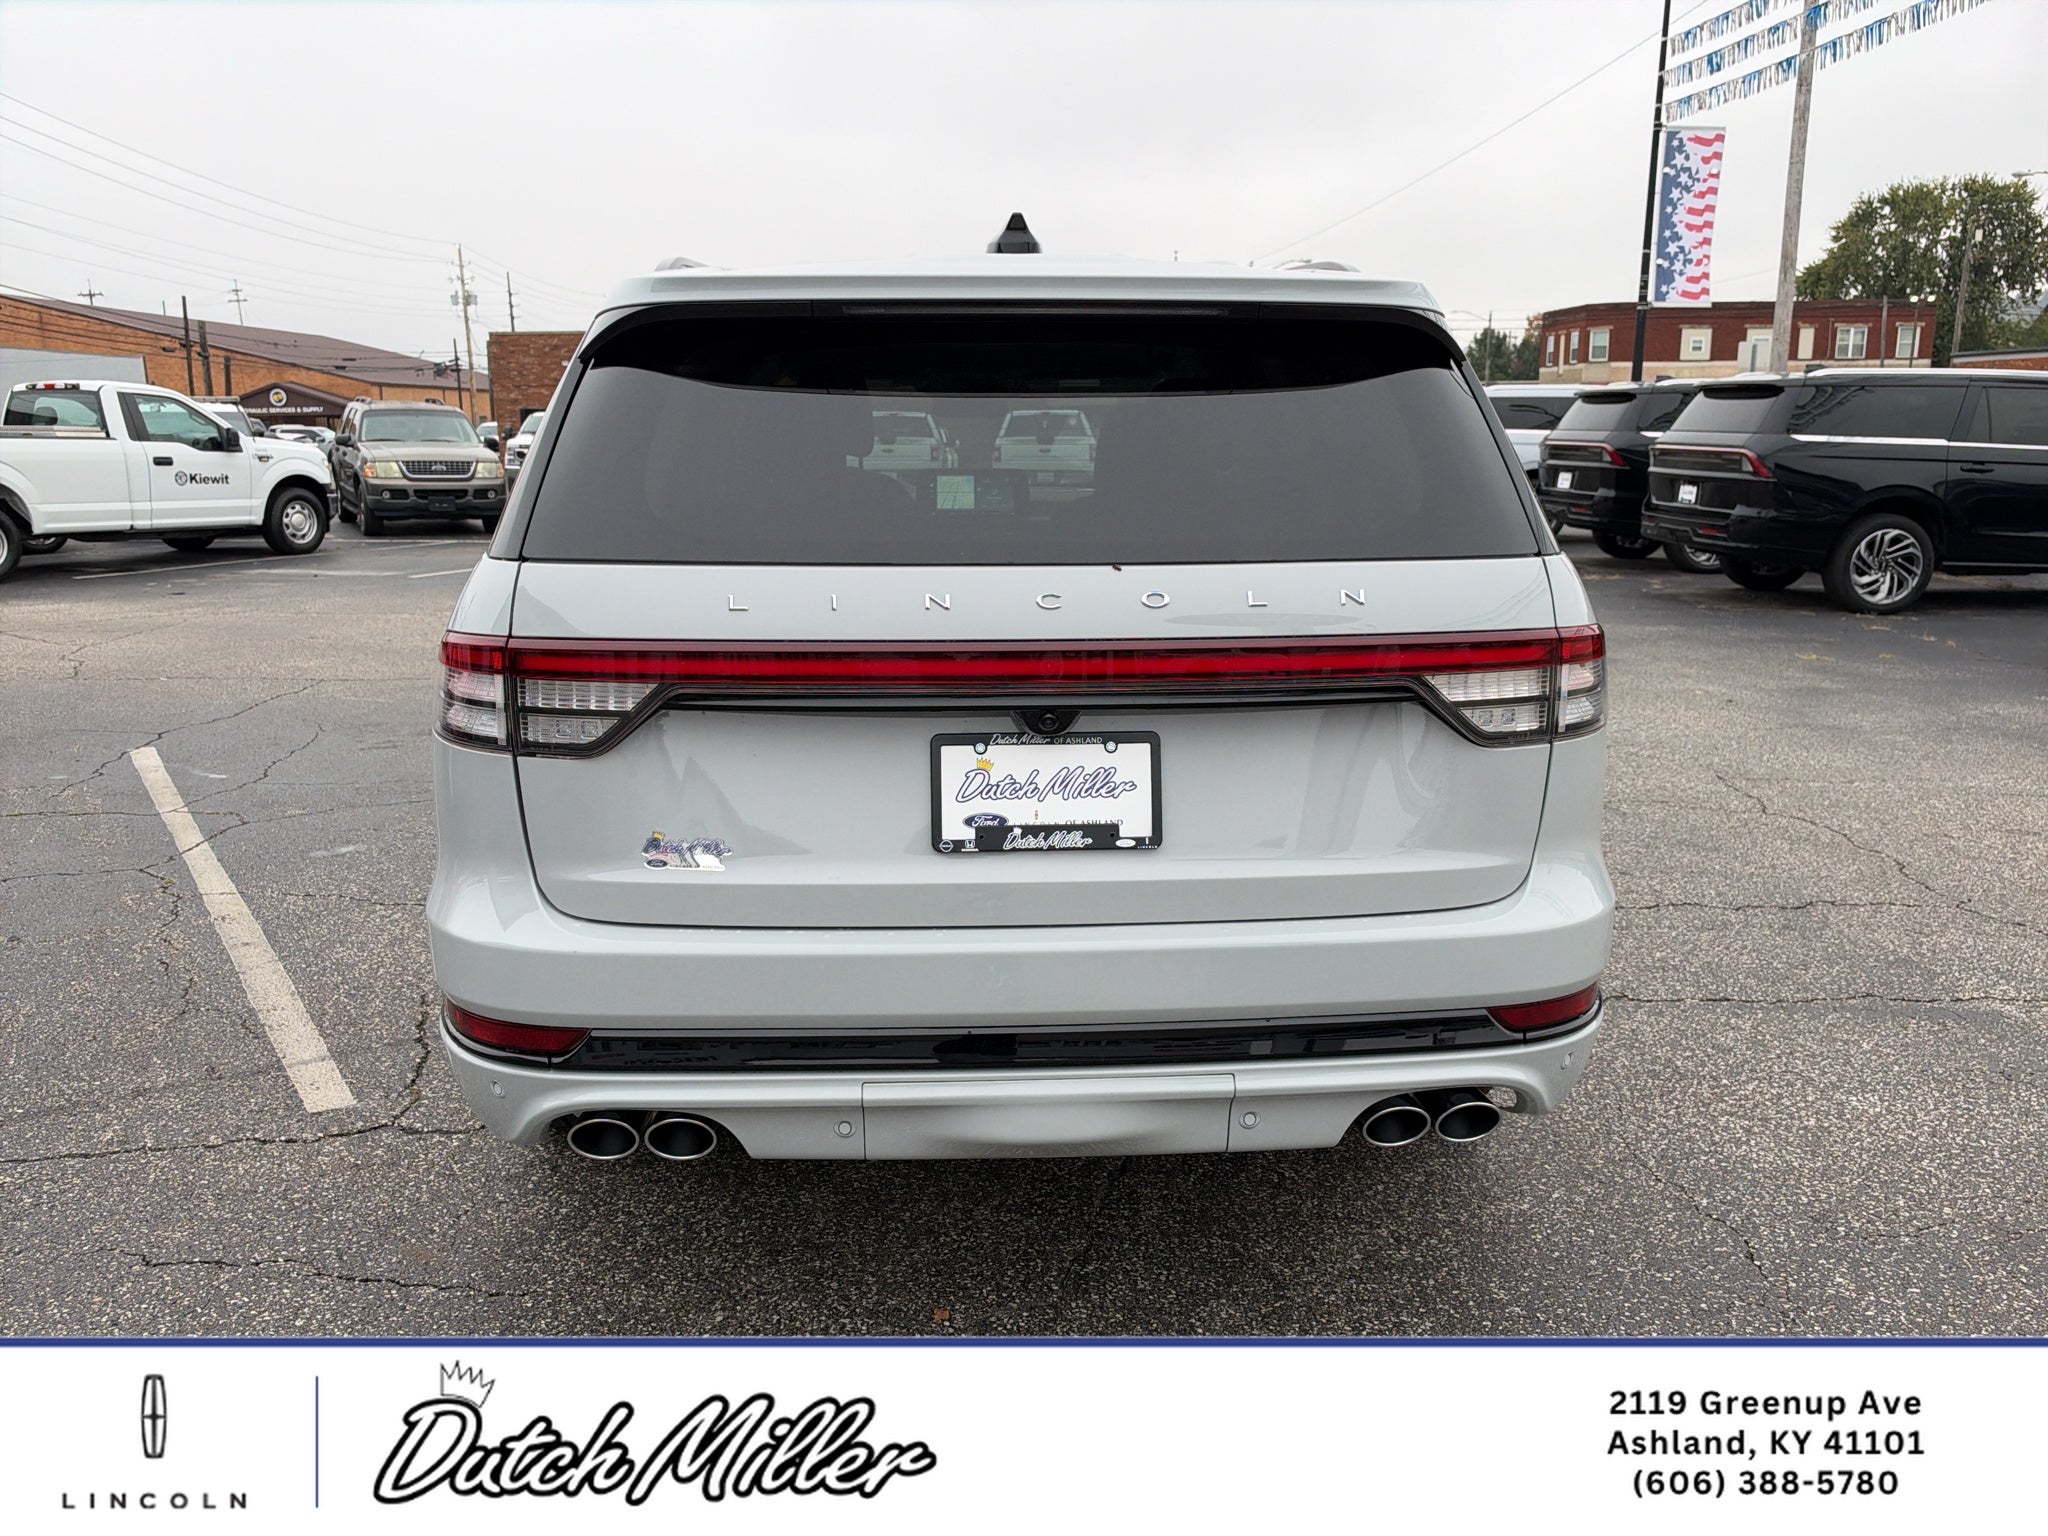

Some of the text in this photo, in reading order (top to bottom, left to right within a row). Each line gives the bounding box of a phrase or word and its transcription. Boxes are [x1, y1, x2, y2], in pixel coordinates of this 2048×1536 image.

[189, 473, 230, 485] Kiewit
[728, 587, 1367, 611] LINCOLN
[990, 733, 1103, 746] Dutch Miller OF ASHLAND
[956, 765, 1138, 803] Dutch Miller
[1003, 832, 1046, 850] Dutch
[1042, 830, 1094, 850] Miller
